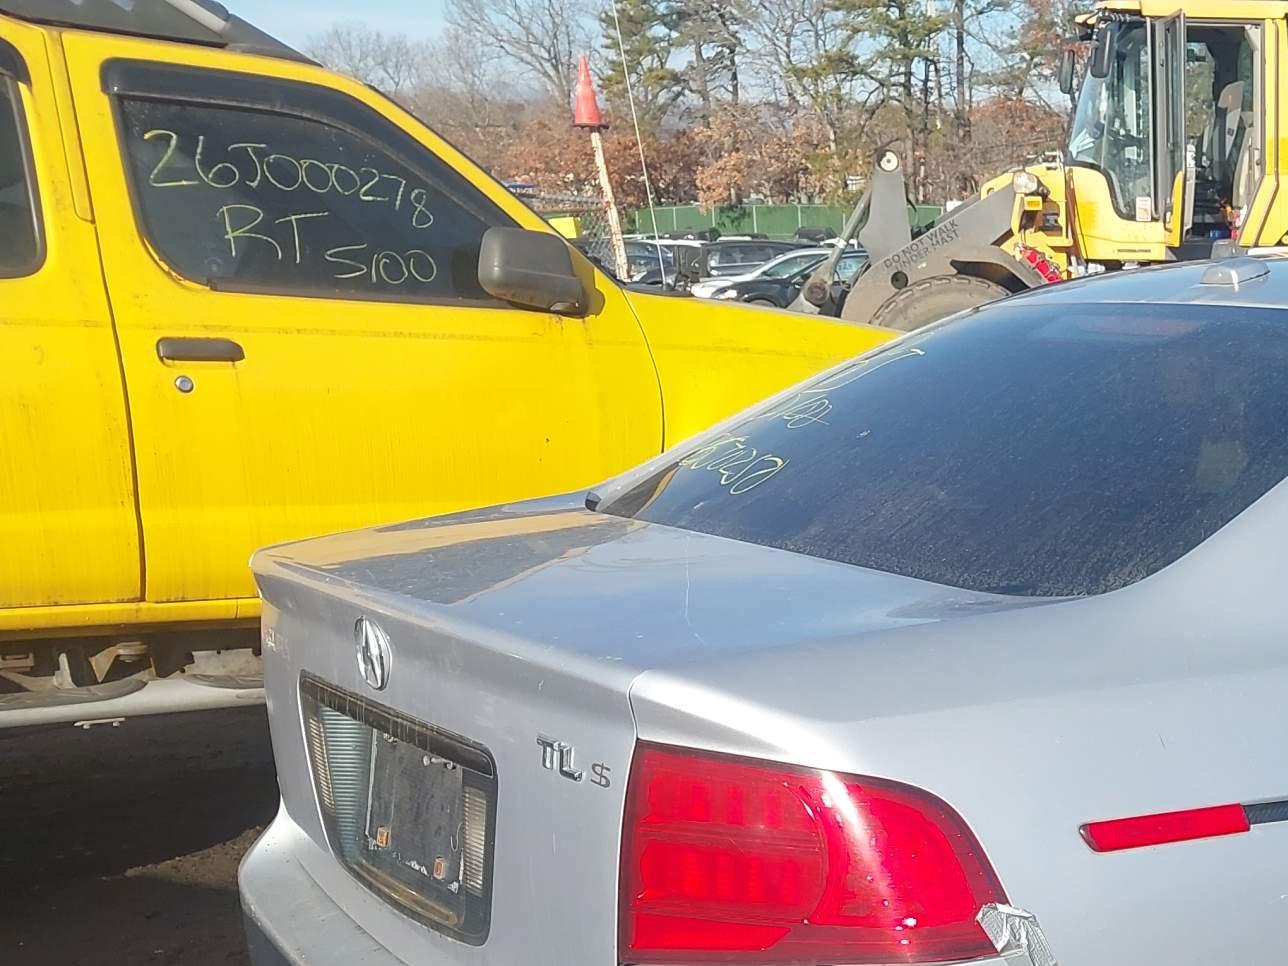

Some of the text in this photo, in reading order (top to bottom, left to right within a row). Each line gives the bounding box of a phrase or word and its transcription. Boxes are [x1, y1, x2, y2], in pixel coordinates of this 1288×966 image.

[143, 129, 434, 229] 26J000278
[217, 204, 329, 264] RT
[883, 220, 959, 269] DO NOT WALK
[895, 230, 960, 271] UNDER MAST
[536, 736, 583, 782] TL
